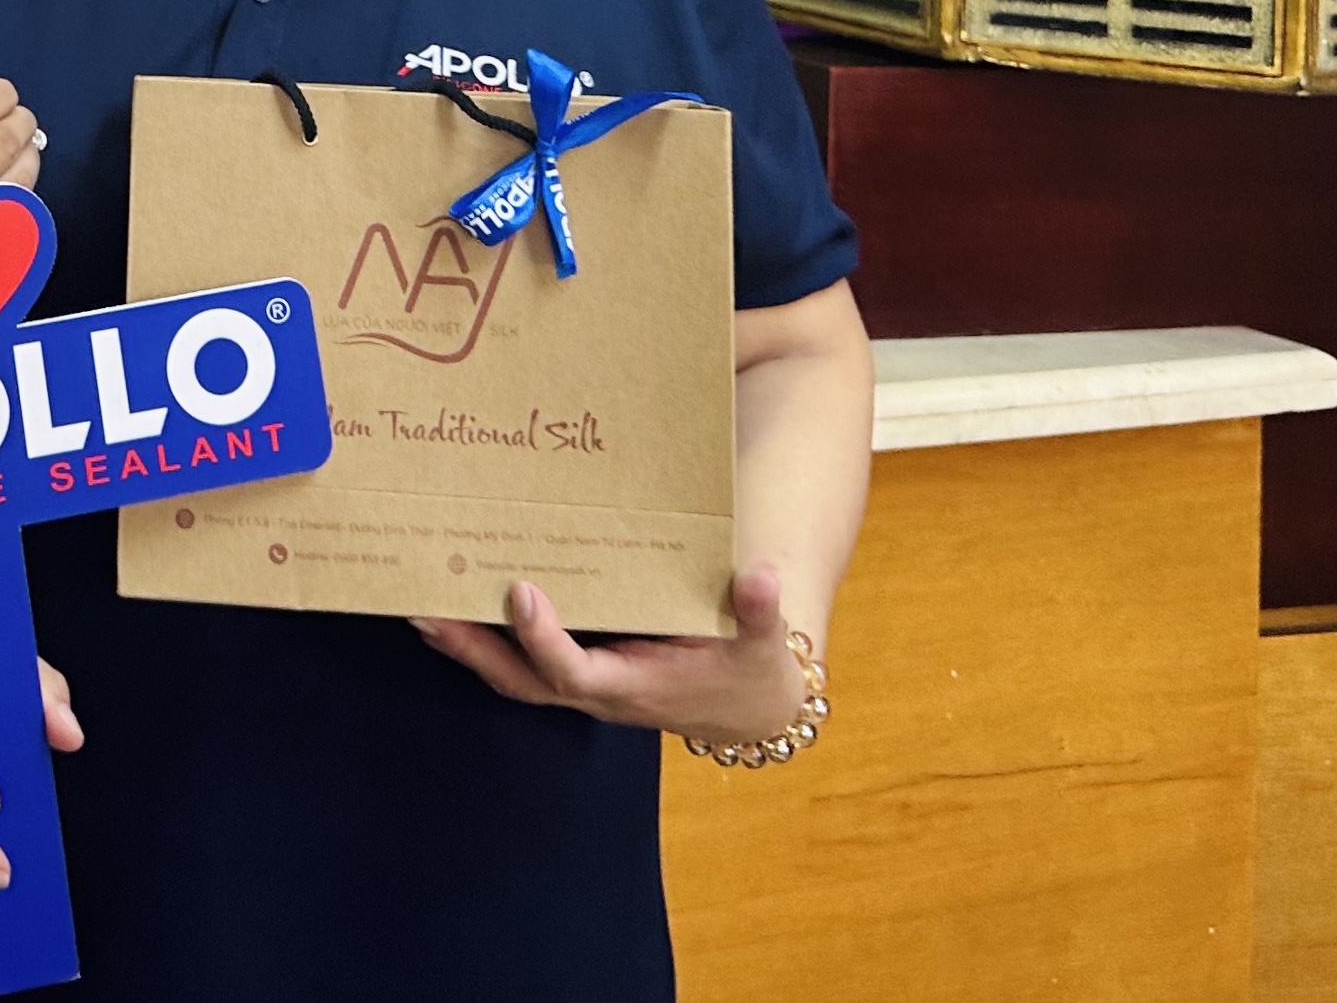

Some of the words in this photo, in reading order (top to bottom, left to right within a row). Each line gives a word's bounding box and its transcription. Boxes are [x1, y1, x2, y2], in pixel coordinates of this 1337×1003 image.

[397, 44, 584, 97] APOL
[378, 406, 539, 452] Traditional
[545, 409, 606, 454] Silk
[49, 422, 288, 493] SEALANT
